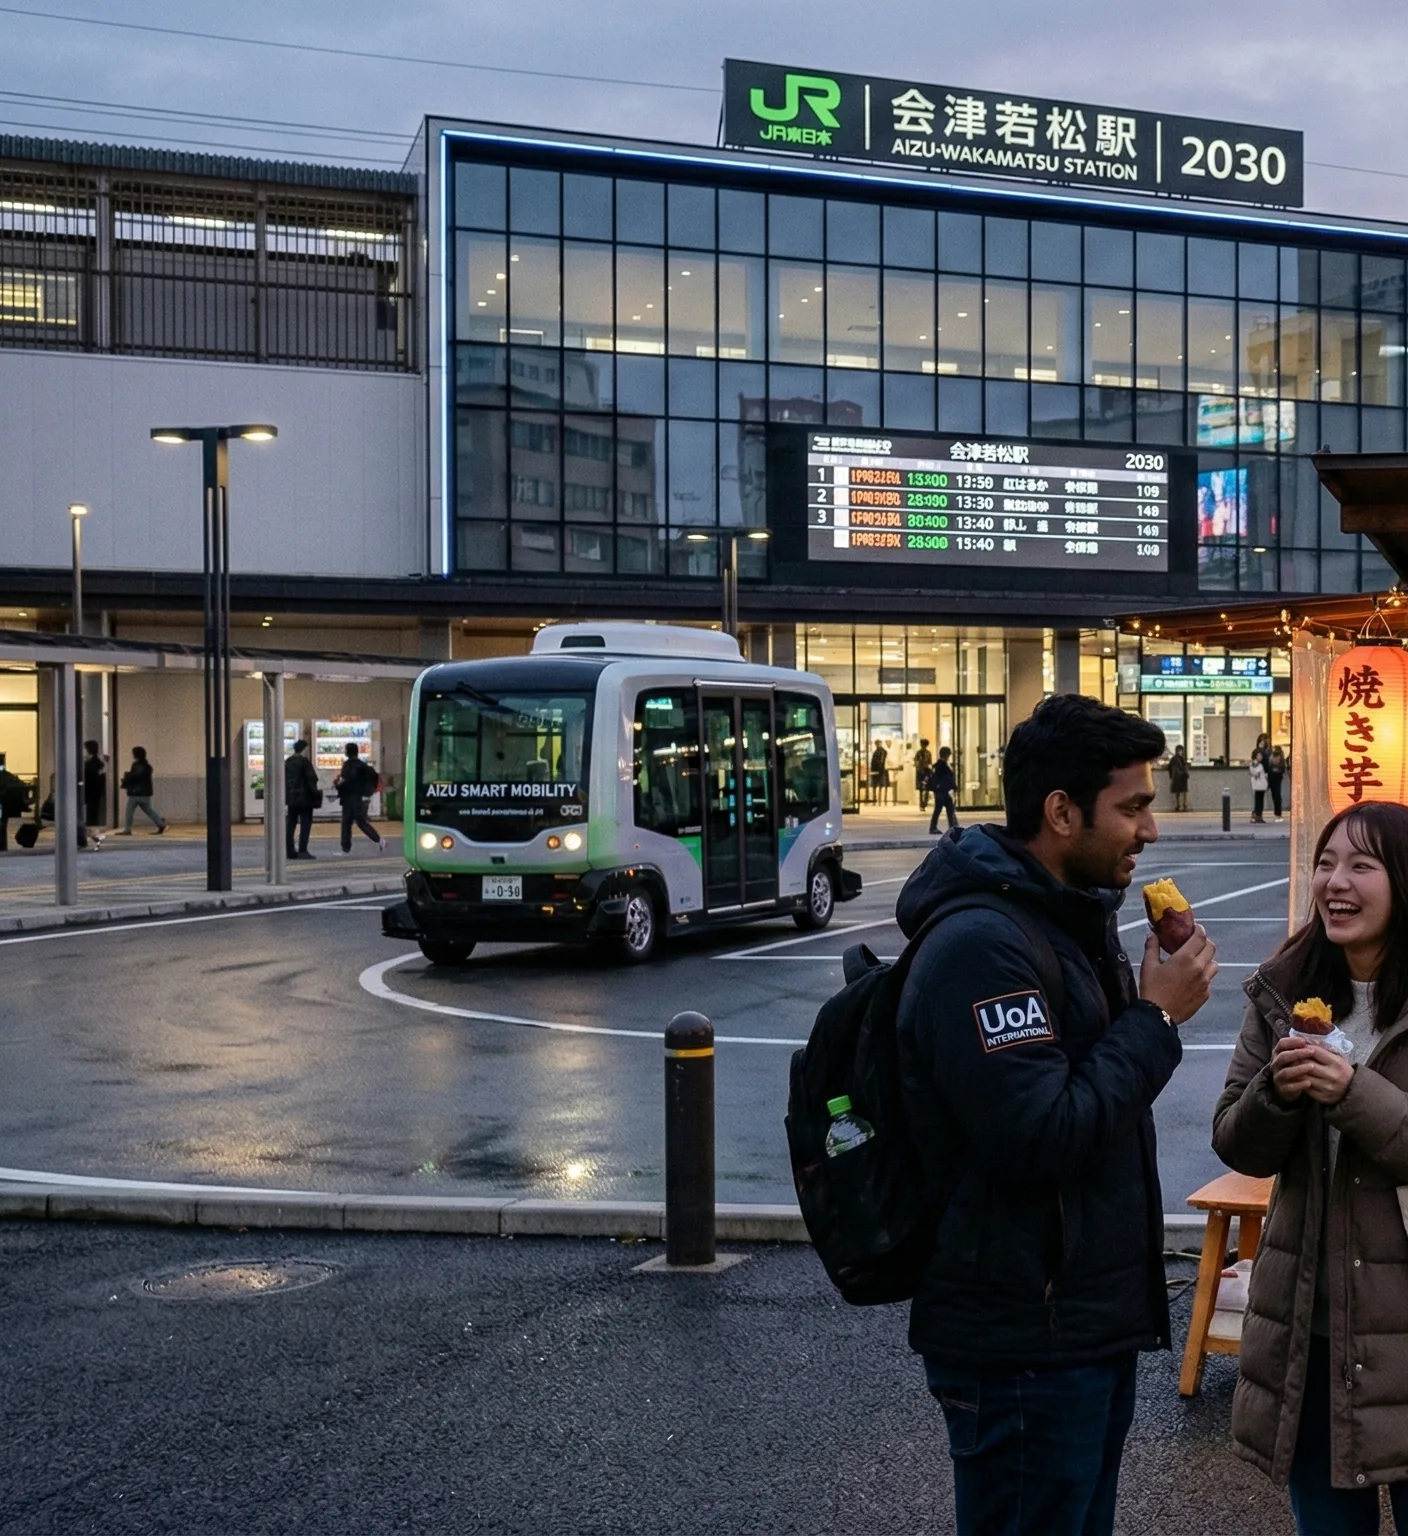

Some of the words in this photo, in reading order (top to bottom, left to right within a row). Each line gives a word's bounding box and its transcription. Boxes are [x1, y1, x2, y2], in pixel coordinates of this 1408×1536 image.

[751, 74, 841, 128] JR
[891, 88, 1137, 159] 会津若松駅
[1063, 157, 1138, 181] STATION
[1180, 135, 1286, 186] 2030
[1125, 453, 1164, 470] 2030
[817, 467, 825, 482] 1
[817, 488, 827, 503] 2
[956, 496, 994, 510] 13:30
[817, 510, 827, 524] 3
[956, 516, 994, 531] 13:40
[1337, 664, 1385, 802] 焼き芋
[427, 784, 457, 797] AIZU
[461, 784, 507, 797] SMART
[511, 784, 576, 797] MOBILITY
[979, 996, 1047, 1034] UoA
